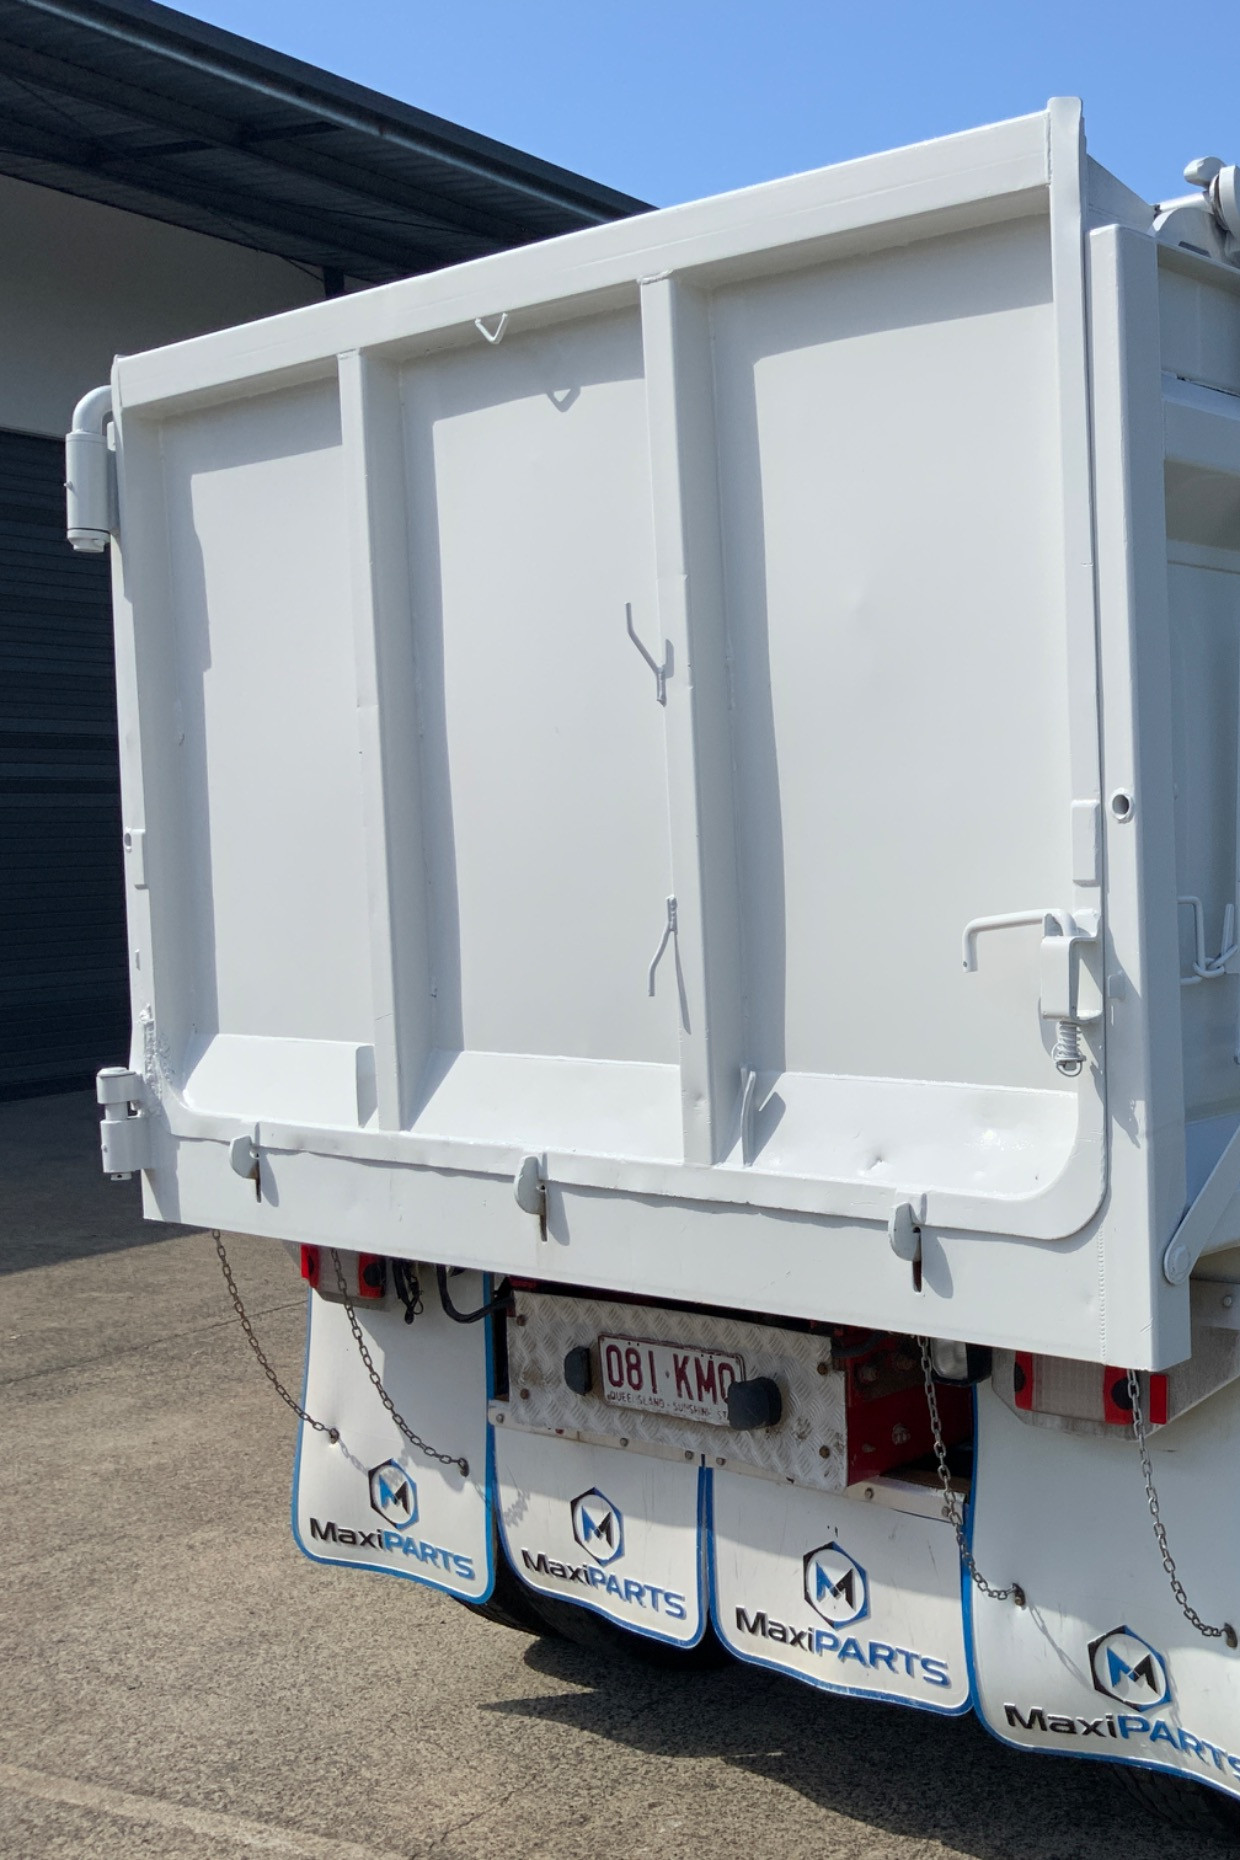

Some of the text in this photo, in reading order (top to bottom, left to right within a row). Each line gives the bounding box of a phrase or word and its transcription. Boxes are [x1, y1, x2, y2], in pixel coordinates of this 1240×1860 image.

[605, 1343, 657, 1395] 081
[609, 1390, 665, 1408] QUEESLAND
[309, 1516, 476, 1580] MaxiPARTS
[520, 1548, 687, 1621] MaxiPARTS
[734, 1605, 952, 1689] MaxiPARTS
